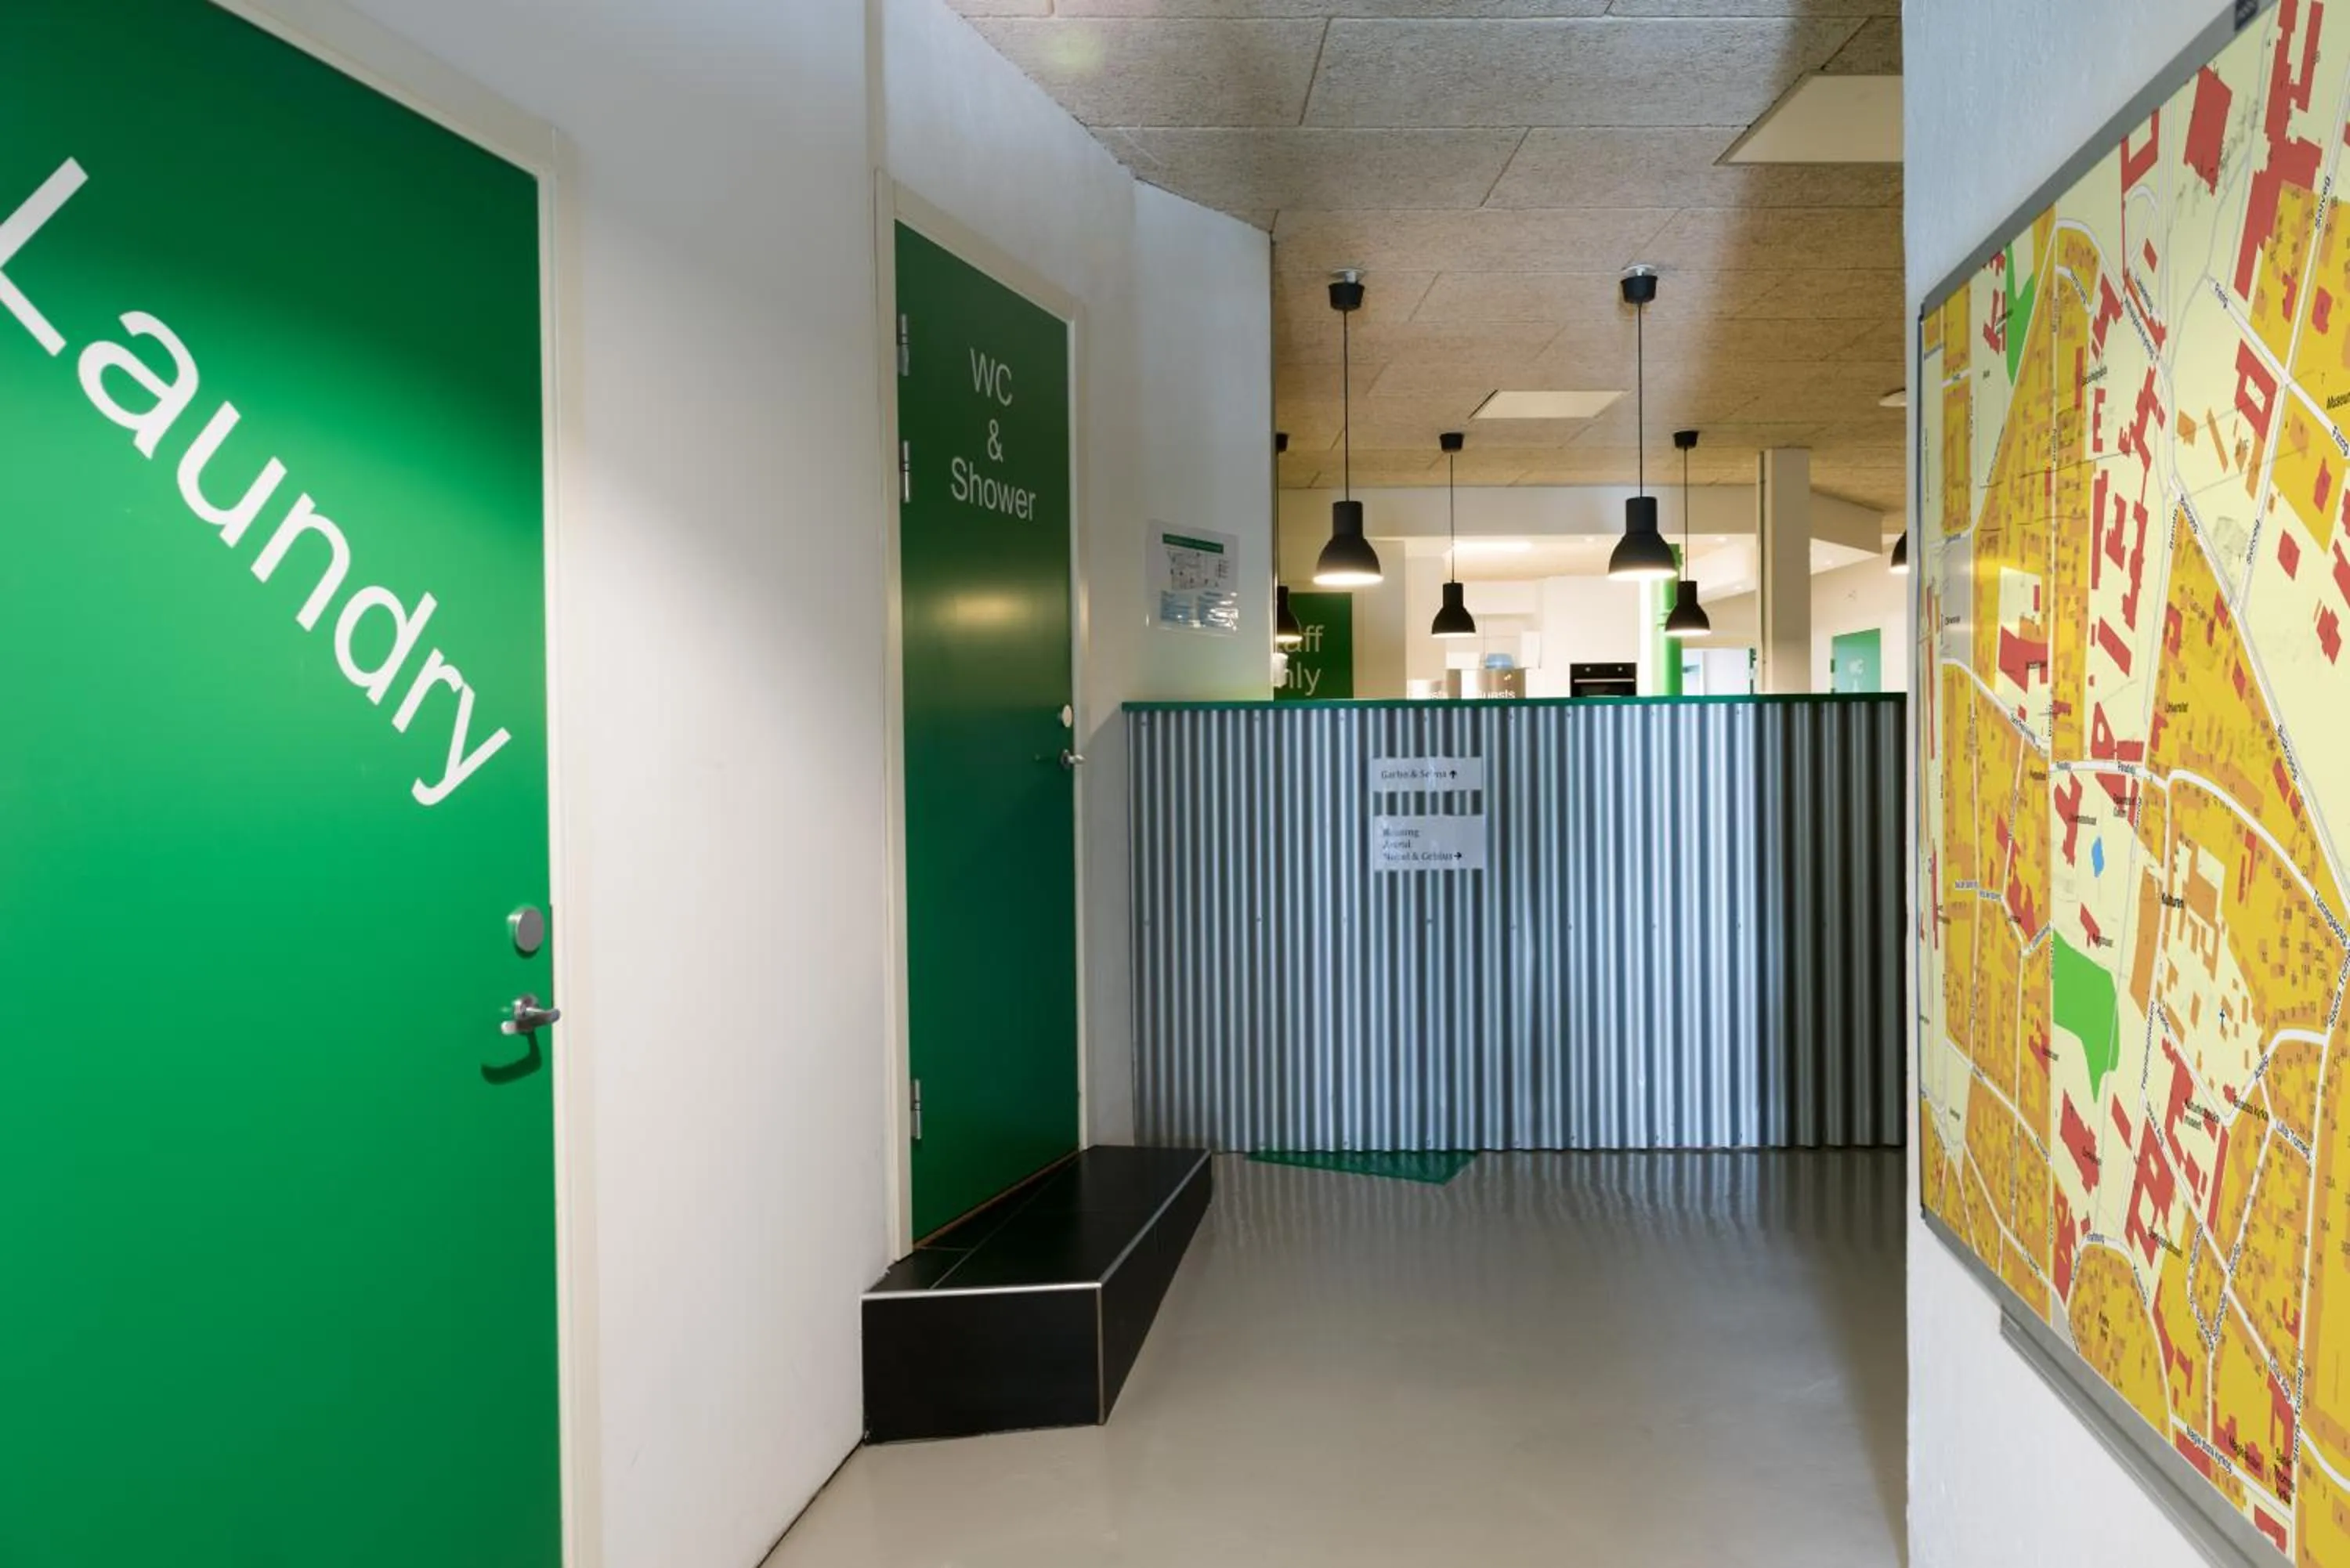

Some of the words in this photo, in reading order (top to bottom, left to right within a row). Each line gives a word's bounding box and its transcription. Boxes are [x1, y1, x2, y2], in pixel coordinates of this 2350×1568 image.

[969, 347, 1013, 406] WC
[987, 418, 1003, 463] &
[0, 156, 512, 807] Laundry
[950, 456, 1036, 521] Shower
[1279, 624, 1325, 653] aff
[1285, 662, 1321, 696] nly
